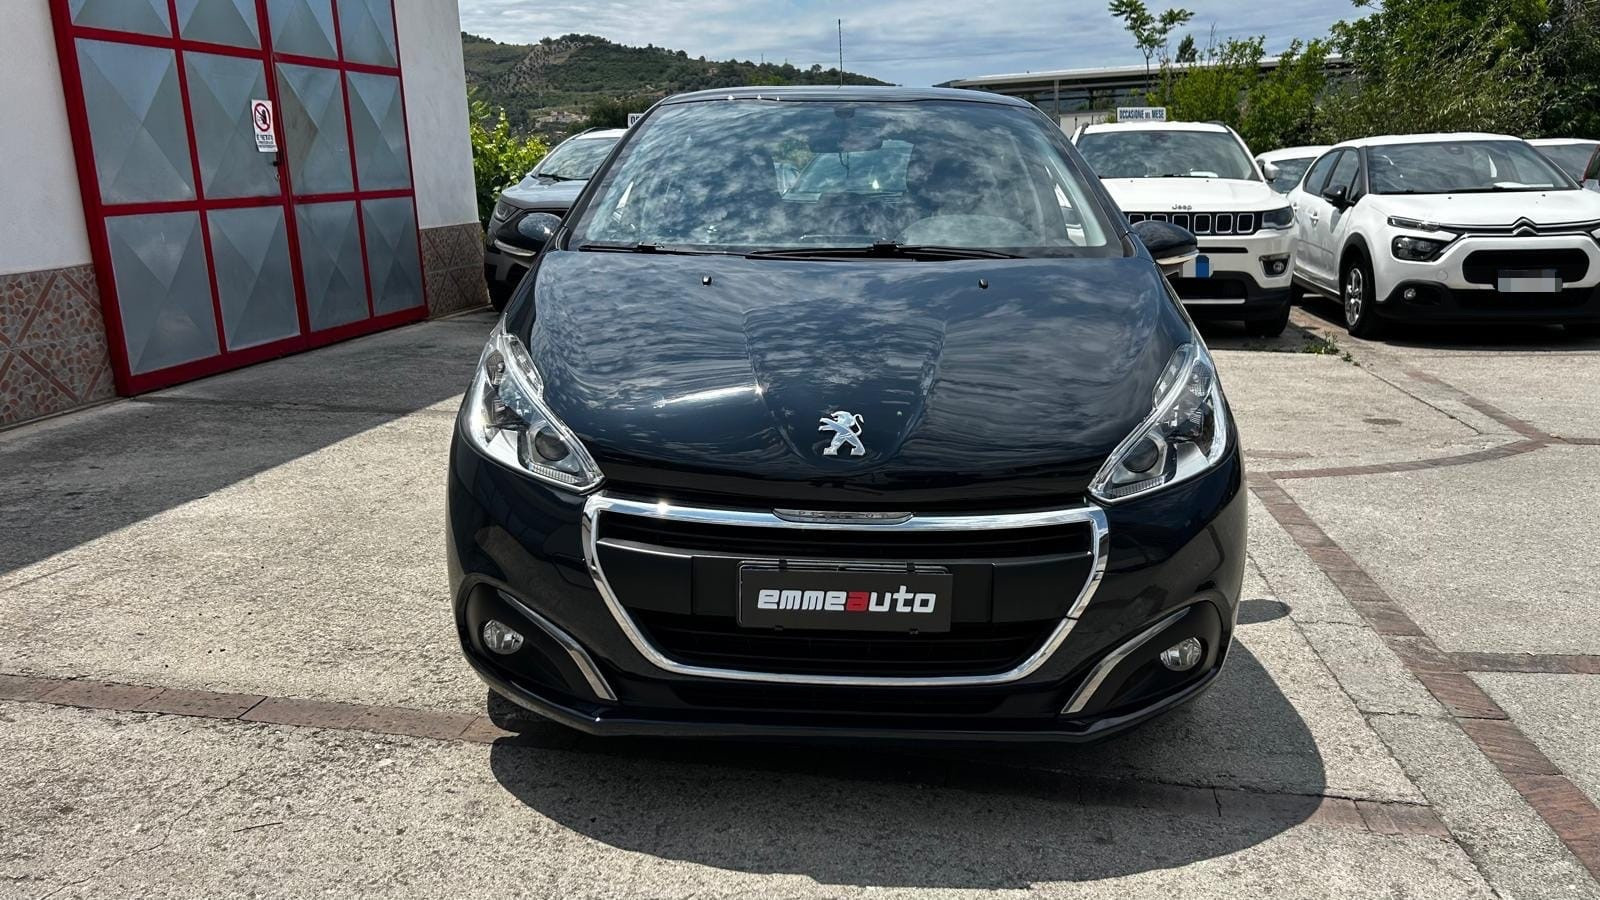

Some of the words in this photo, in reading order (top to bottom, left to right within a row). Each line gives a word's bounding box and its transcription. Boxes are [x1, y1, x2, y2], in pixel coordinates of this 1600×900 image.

[1119, 109, 1144, 119] OCCASIONE
[1152, 109, 1164, 119] MESE
[1171, 203, 1193, 212] Jeep
[757, 585, 936, 613] emmeauto
